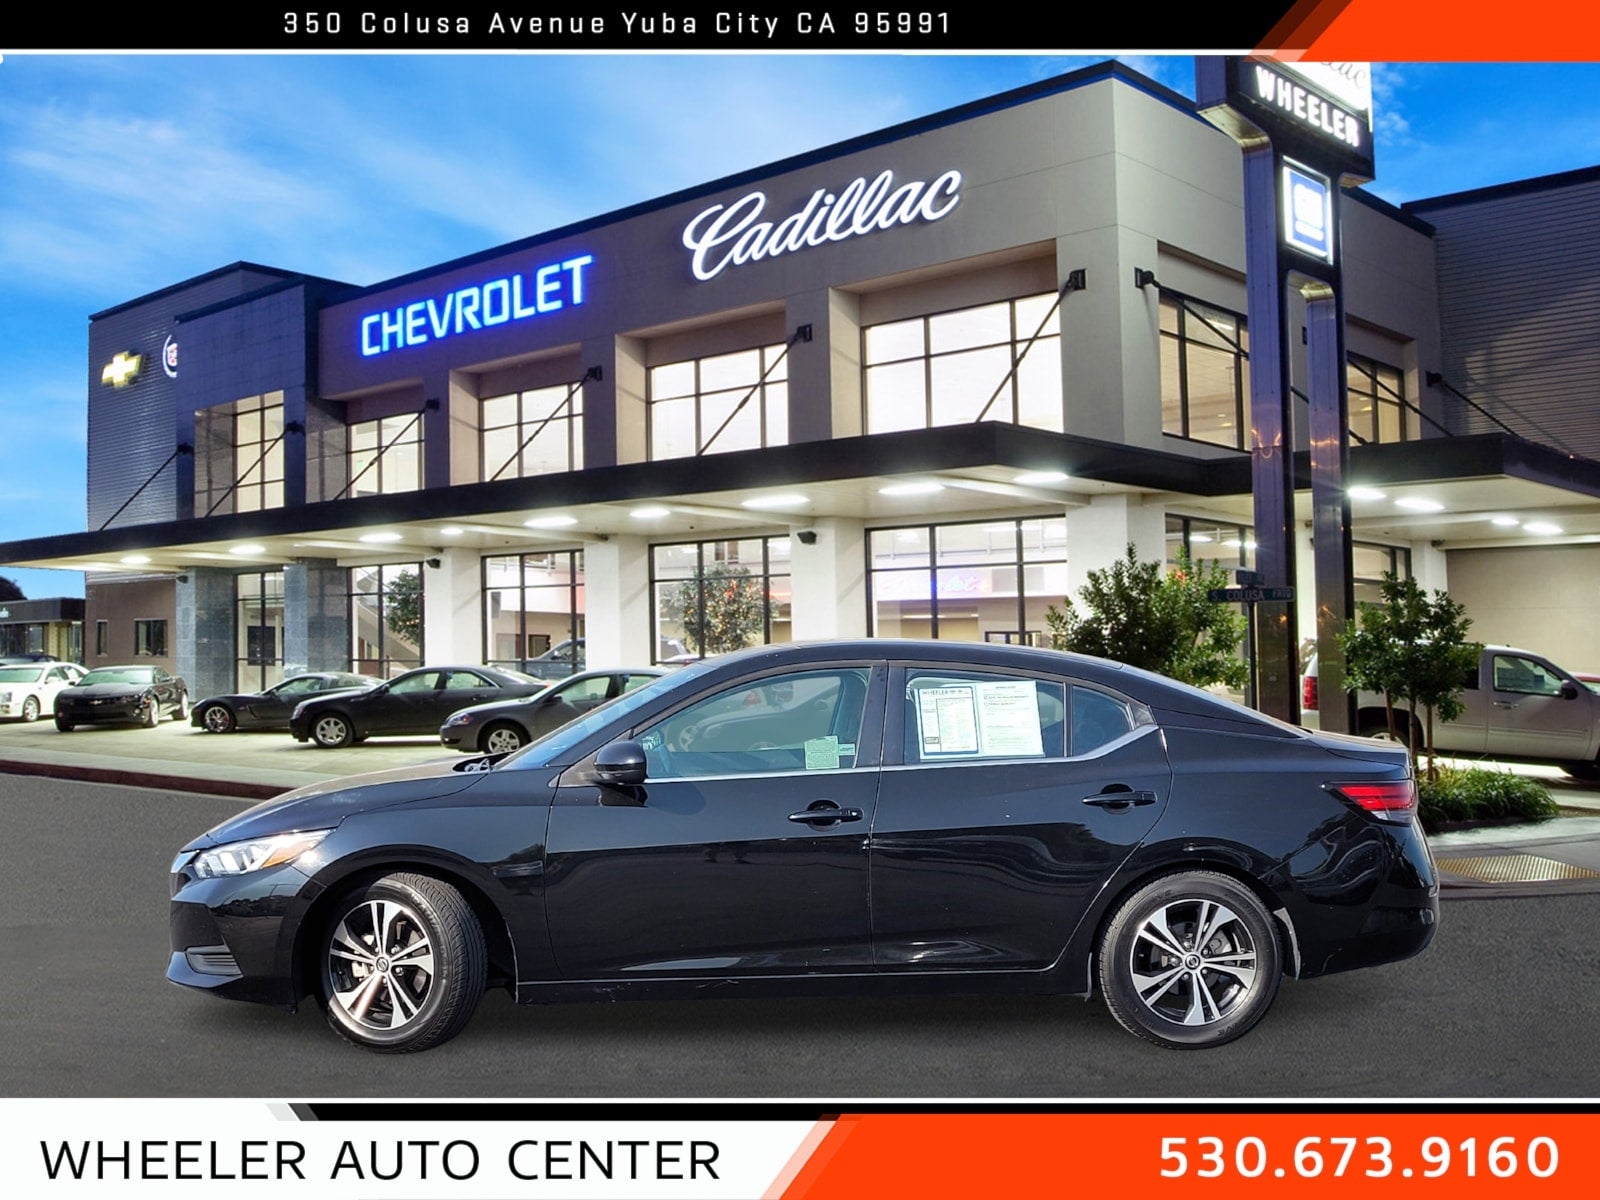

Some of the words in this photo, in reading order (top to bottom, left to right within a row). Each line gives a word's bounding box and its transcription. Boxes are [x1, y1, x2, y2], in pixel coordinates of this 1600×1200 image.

[1255, 65, 1359, 147] WHEELER
[682, 169, 963, 281] Cadillac
[361, 255, 594, 356] CHEVROLET
[1227, 590, 1265, 601] COLUSA
